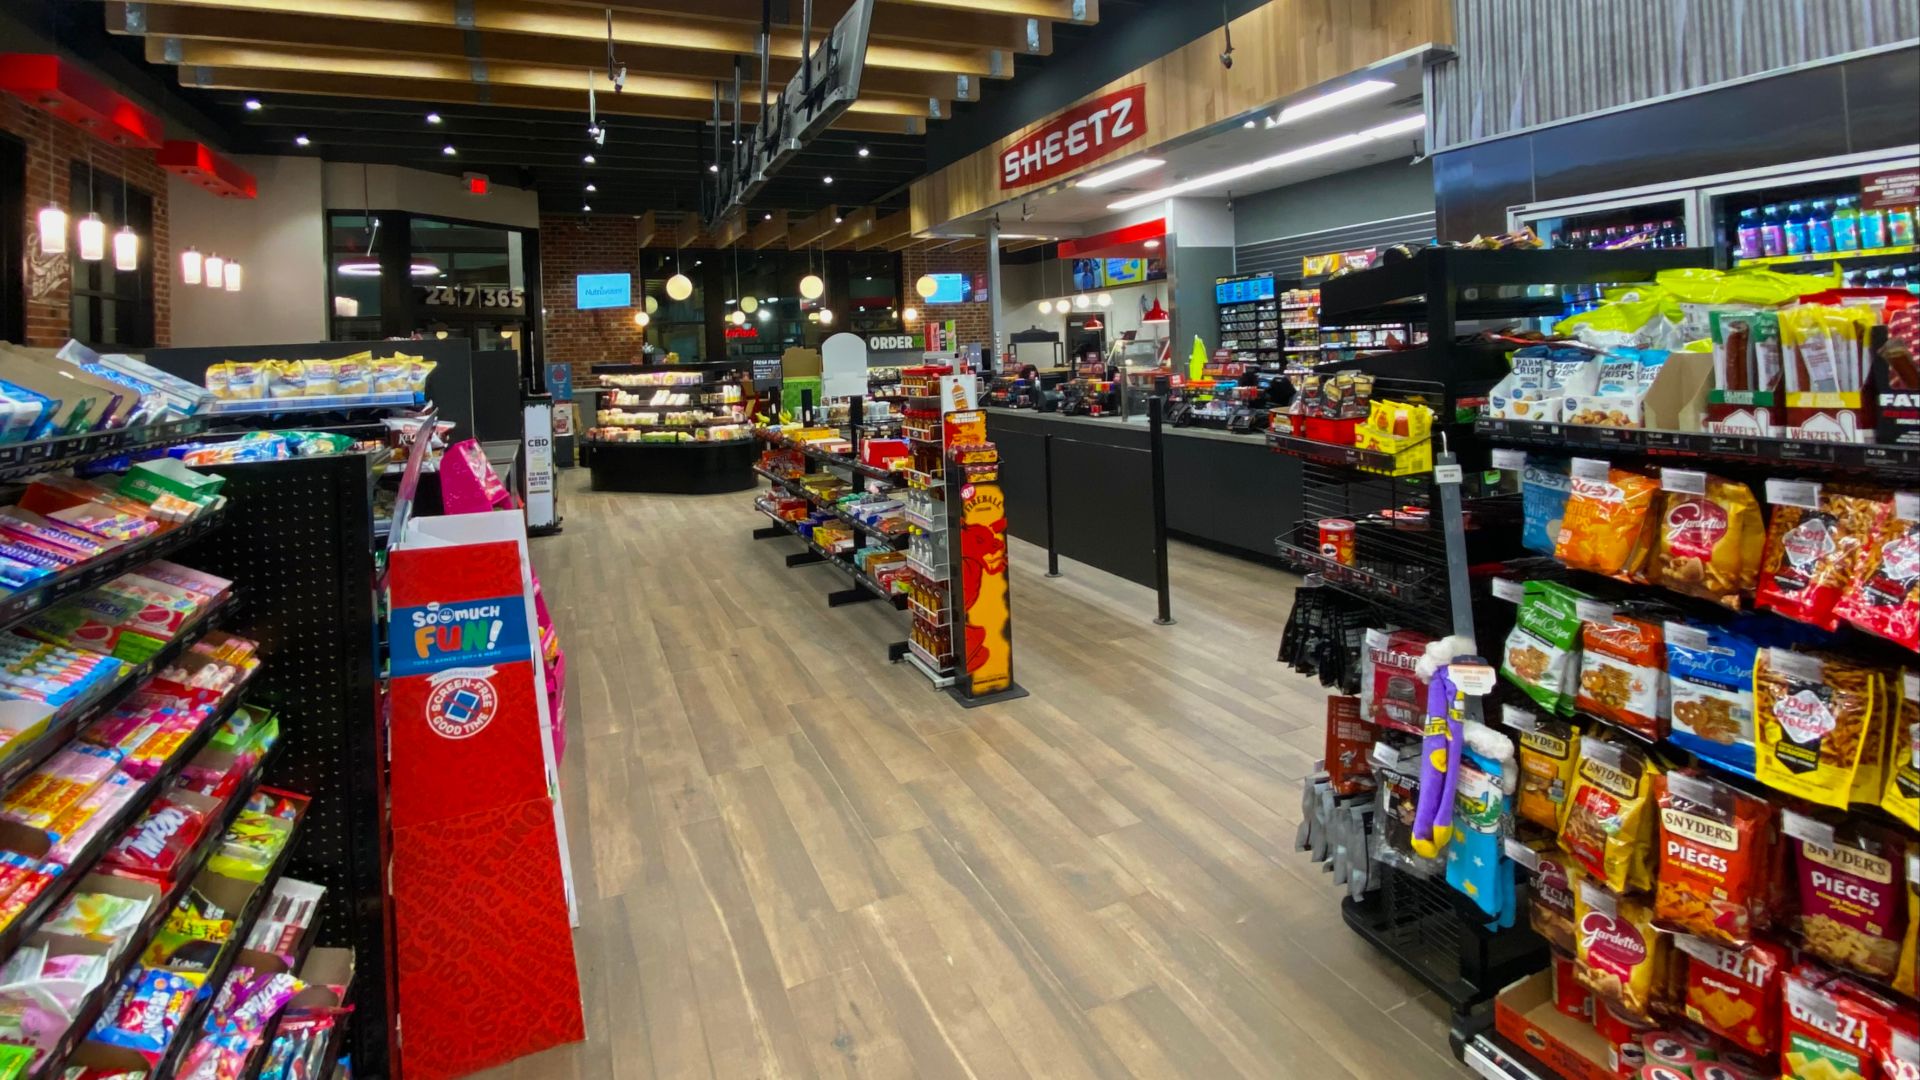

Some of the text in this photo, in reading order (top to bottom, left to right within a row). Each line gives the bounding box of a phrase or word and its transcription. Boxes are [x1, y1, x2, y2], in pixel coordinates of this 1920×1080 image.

[1004, 97, 1134, 182] SHEETZ
[484, 287, 523, 308] 365
[870, 336, 913, 350] ORDER
[1712, 425, 1758, 436] WENZEL'S
[1791, 429, 1841, 441] WENZEL'S
[528, 439, 548, 447] CBD
[1524, 467, 1569, 489] QUEST
[965, 495, 1002, 512] FIREBALL
[414, 619, 504, 659] FUN!
[1370, 648, 1399, 666] WILD
[431, 679, 493, 712] SCREEN-FREE
[433, 712, 489, 735] GOOD TIME
[1665, 812, 1732, 842] SNYDER'S
[1668, 841, 1728, 873] PIECES
[1811, 871, 1880, 907] PIECES
[1581, 911, 1645, 954] Gardetto's
